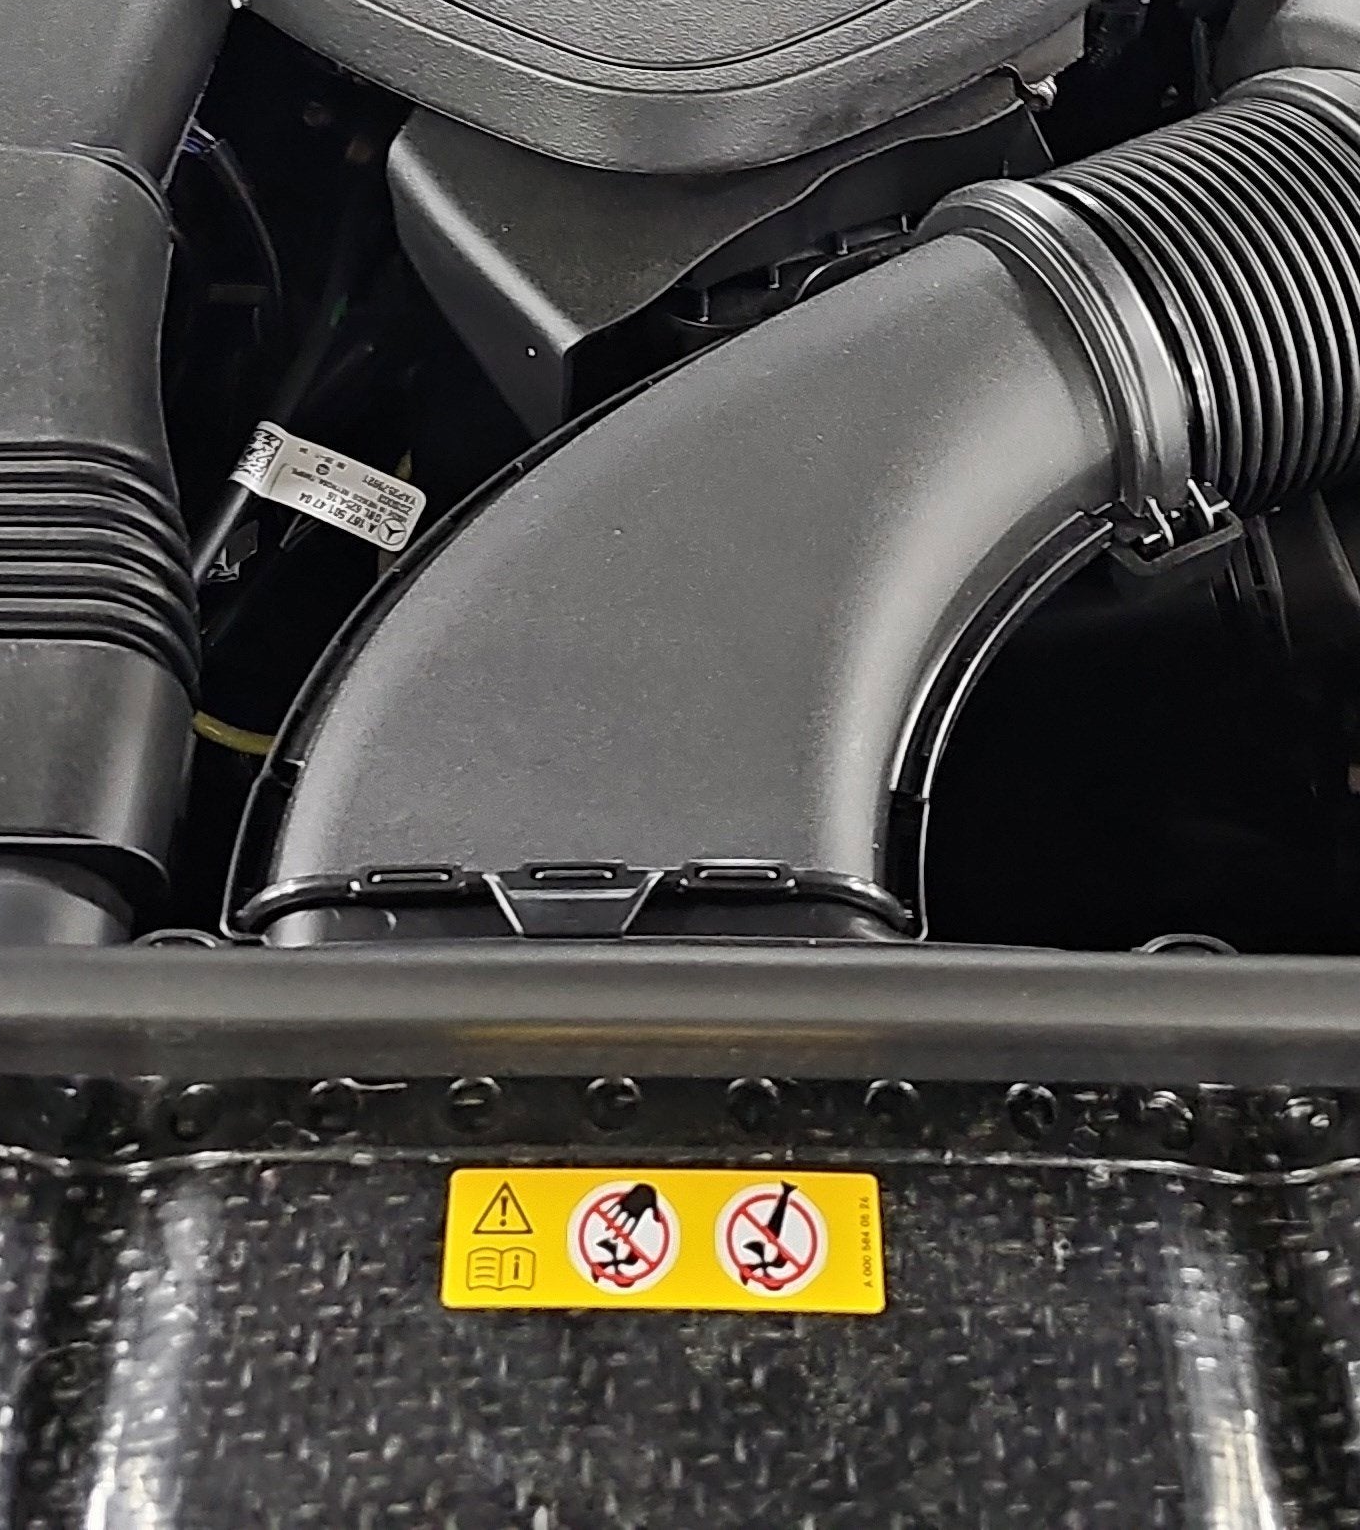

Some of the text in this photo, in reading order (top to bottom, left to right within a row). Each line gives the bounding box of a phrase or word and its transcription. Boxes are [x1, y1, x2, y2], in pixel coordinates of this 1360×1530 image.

[367, 522, 378, 535] A
[863, 1255, 872, 1277] 000
[863, 1279, 873, 1288] A
